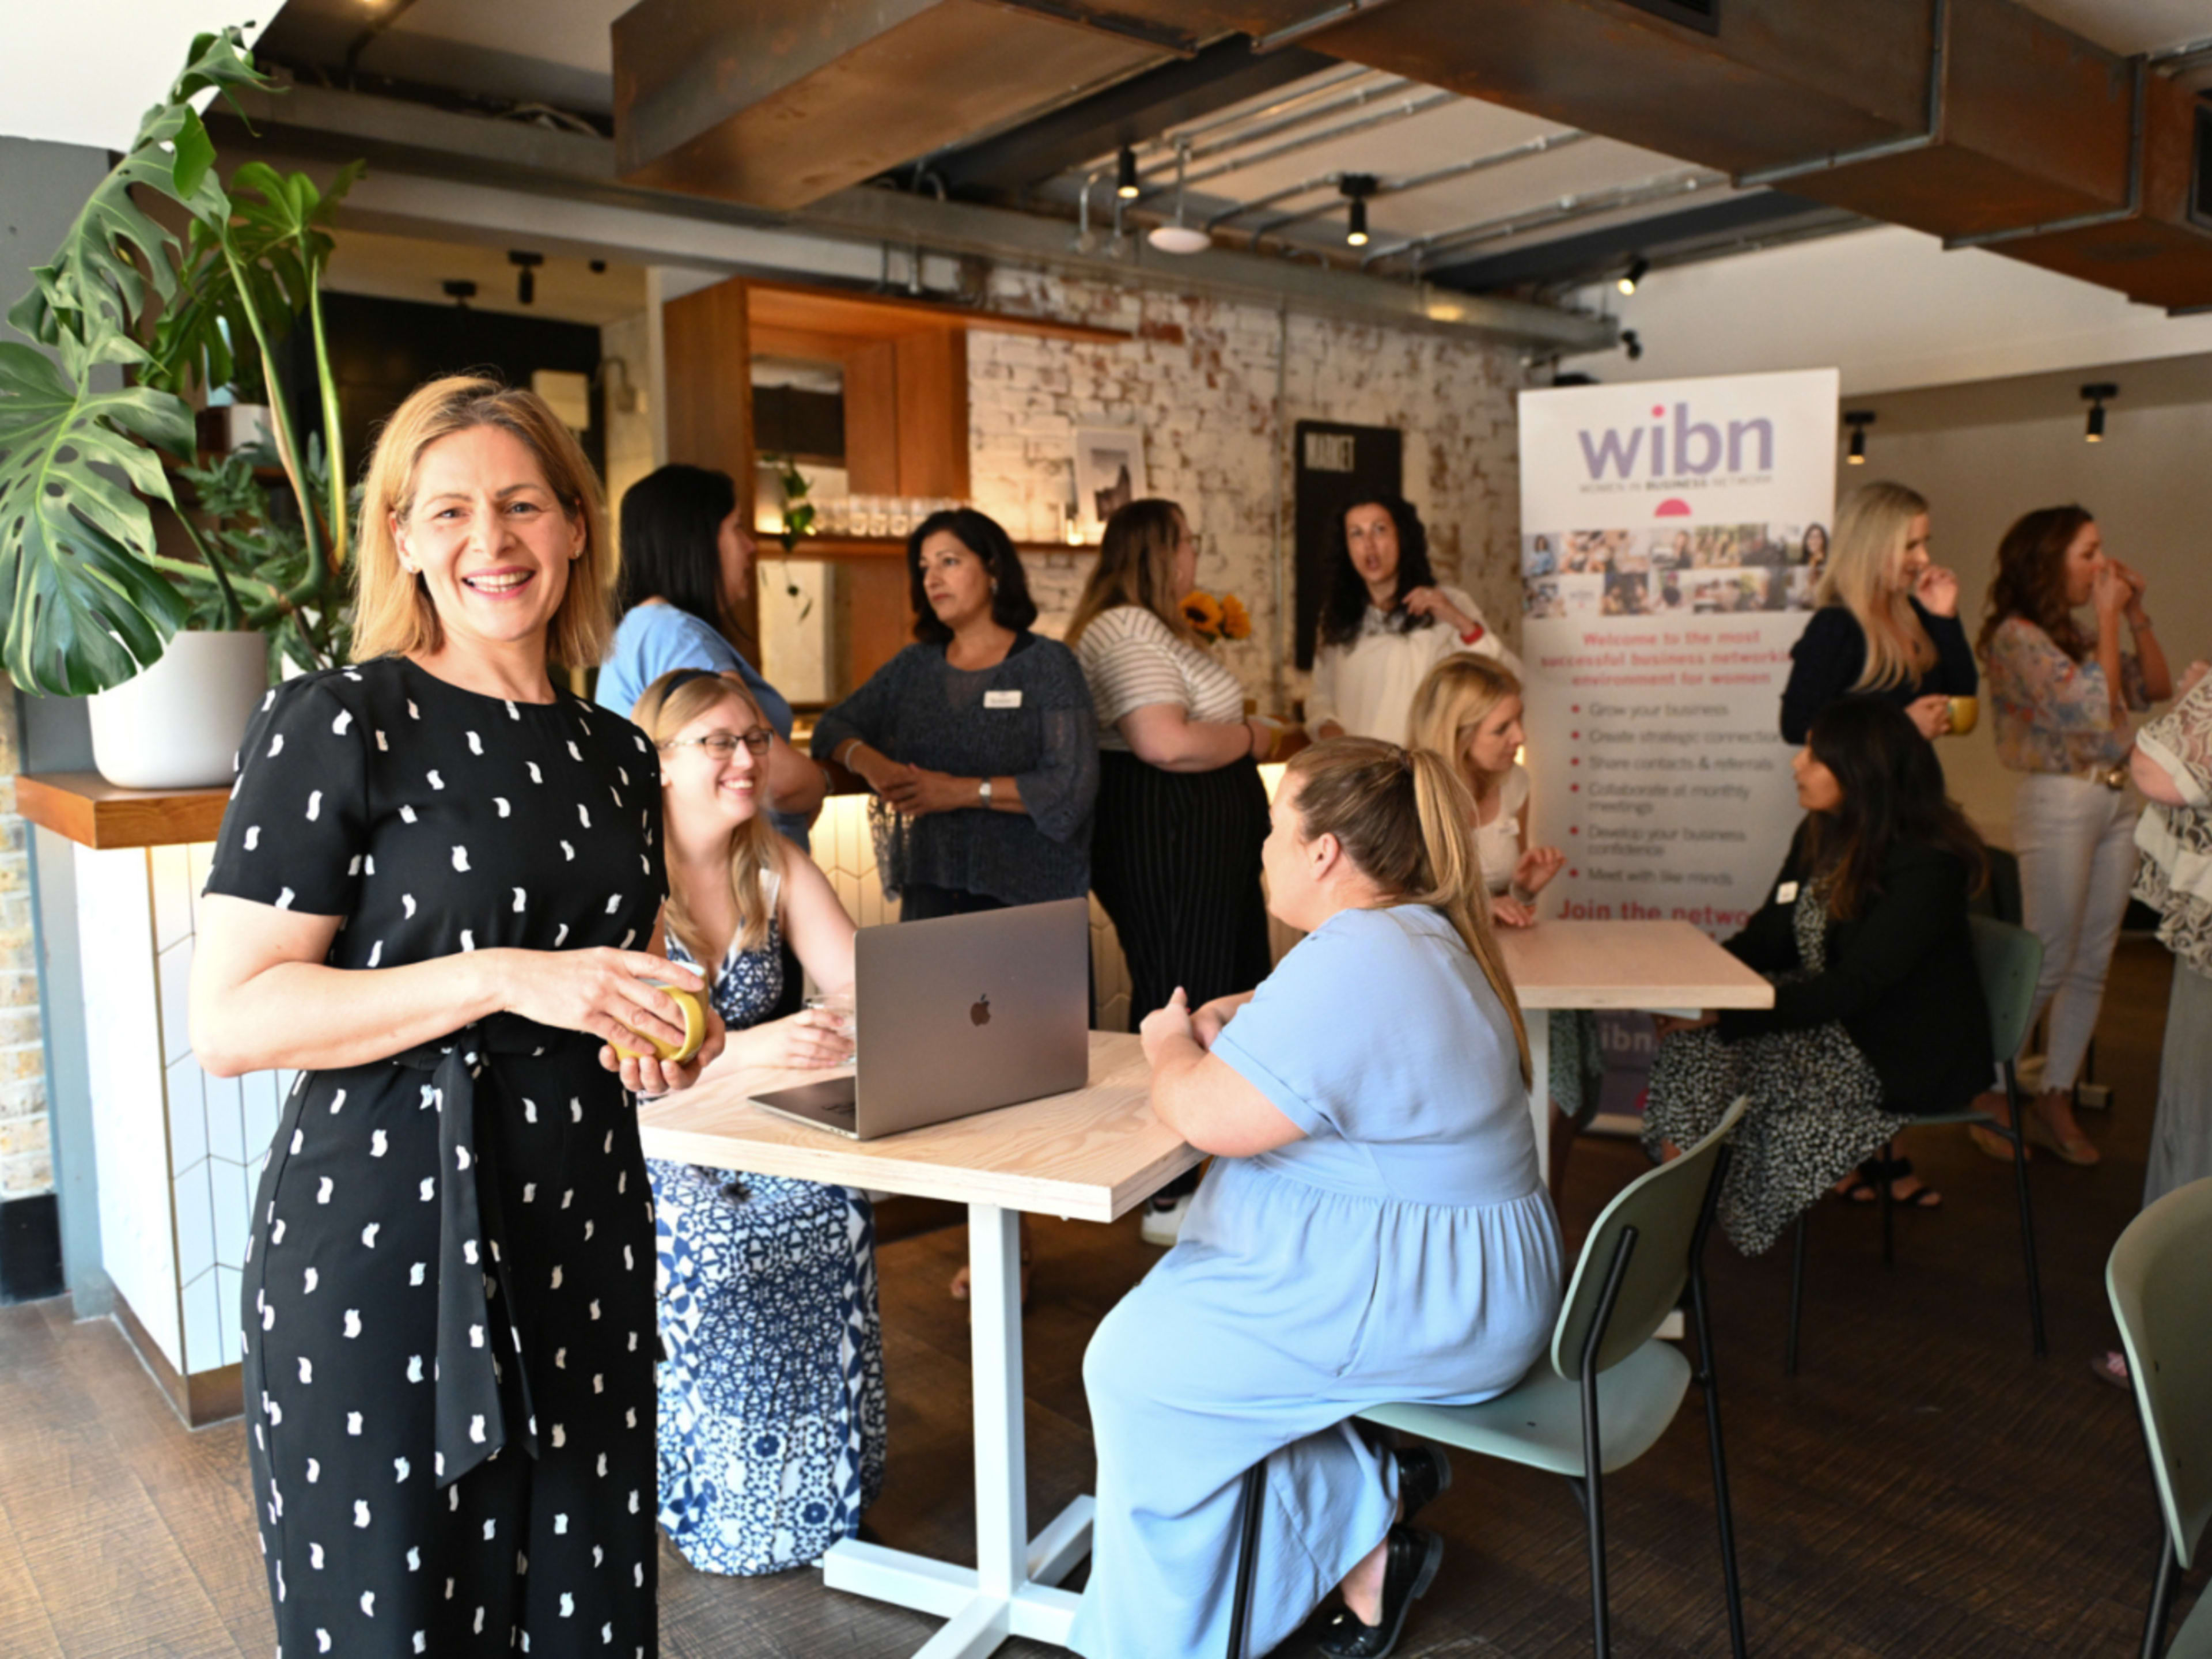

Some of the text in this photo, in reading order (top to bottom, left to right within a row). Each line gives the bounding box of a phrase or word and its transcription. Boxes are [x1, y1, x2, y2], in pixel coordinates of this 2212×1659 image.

[1578, 402, 1773, 479] wibn
[1646, 477, 1708, 491] BUSINESS
[1582, 630, 1761, 646] Welcome to the most
[1541, 653, 1625, 668] successful
[1631, 652, 1705, 666] business
[1571, 672, 1771, 687] environment for women
[1589, 703, 1729, 719] Grow your business
[1589, 730, 1779, 747] Create strategic connection
[1589, 756, 1774, 770] Share contacts & referrals
[1588, 782, 1750, 801] Collaborate at monthly
[1588, 800, 1654, 816] meetings
[1588, 824, 1746, 843] Develop your business
[1588, 842, 1665, 855] confidence
[1588, 868, 1733, 885] Meet with like minds
[1558, 899, 1749, 926] Join the netwo
